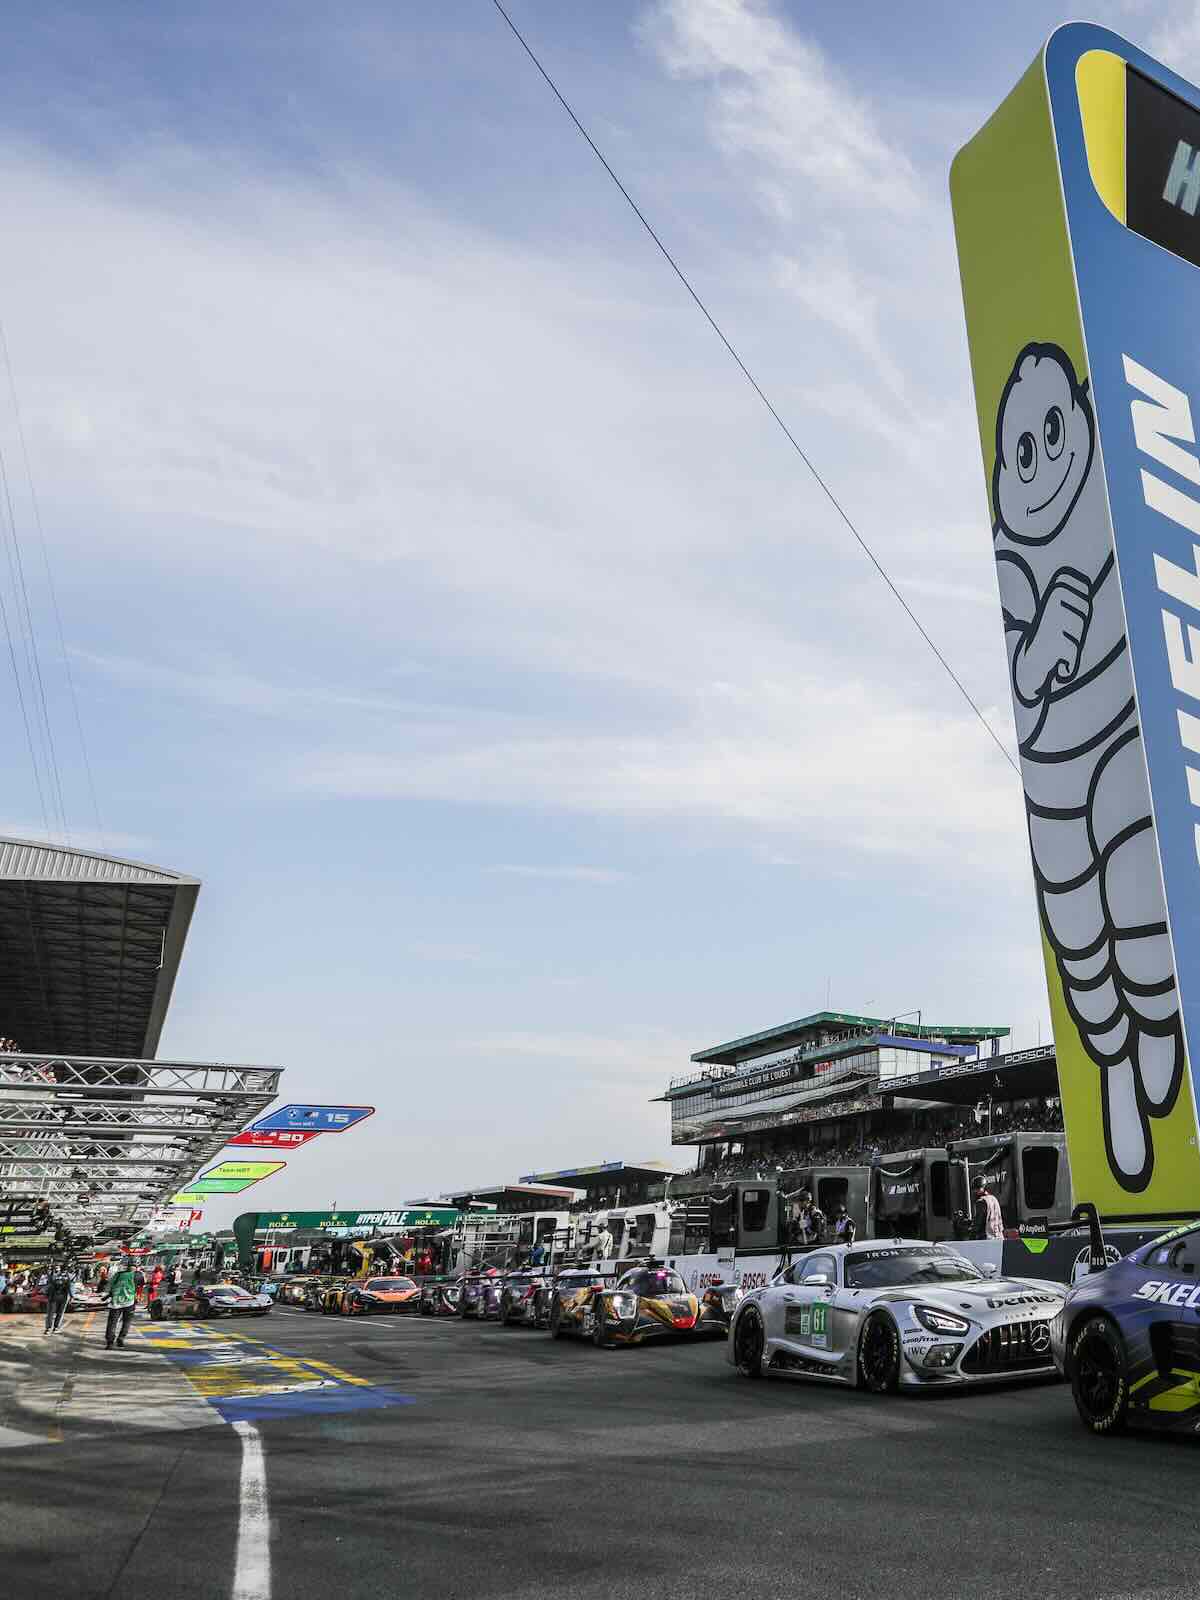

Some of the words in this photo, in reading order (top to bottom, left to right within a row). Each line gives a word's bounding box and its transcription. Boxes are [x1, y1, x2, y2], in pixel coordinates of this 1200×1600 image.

[938, 1061, 988, 1078] PORSCHE
[877, 1074, 920, 1090] PORSCHE
[324, 1113, 349, 1124] 15
[278, 1133, 304, 1142] 20
[866, 1249, 899, 1259] IRON
[743, 1272, 767, 1289] BOSCH
[813, 1308, 825, 1331] 61
[908, 1346, 927, 1355] IWC
